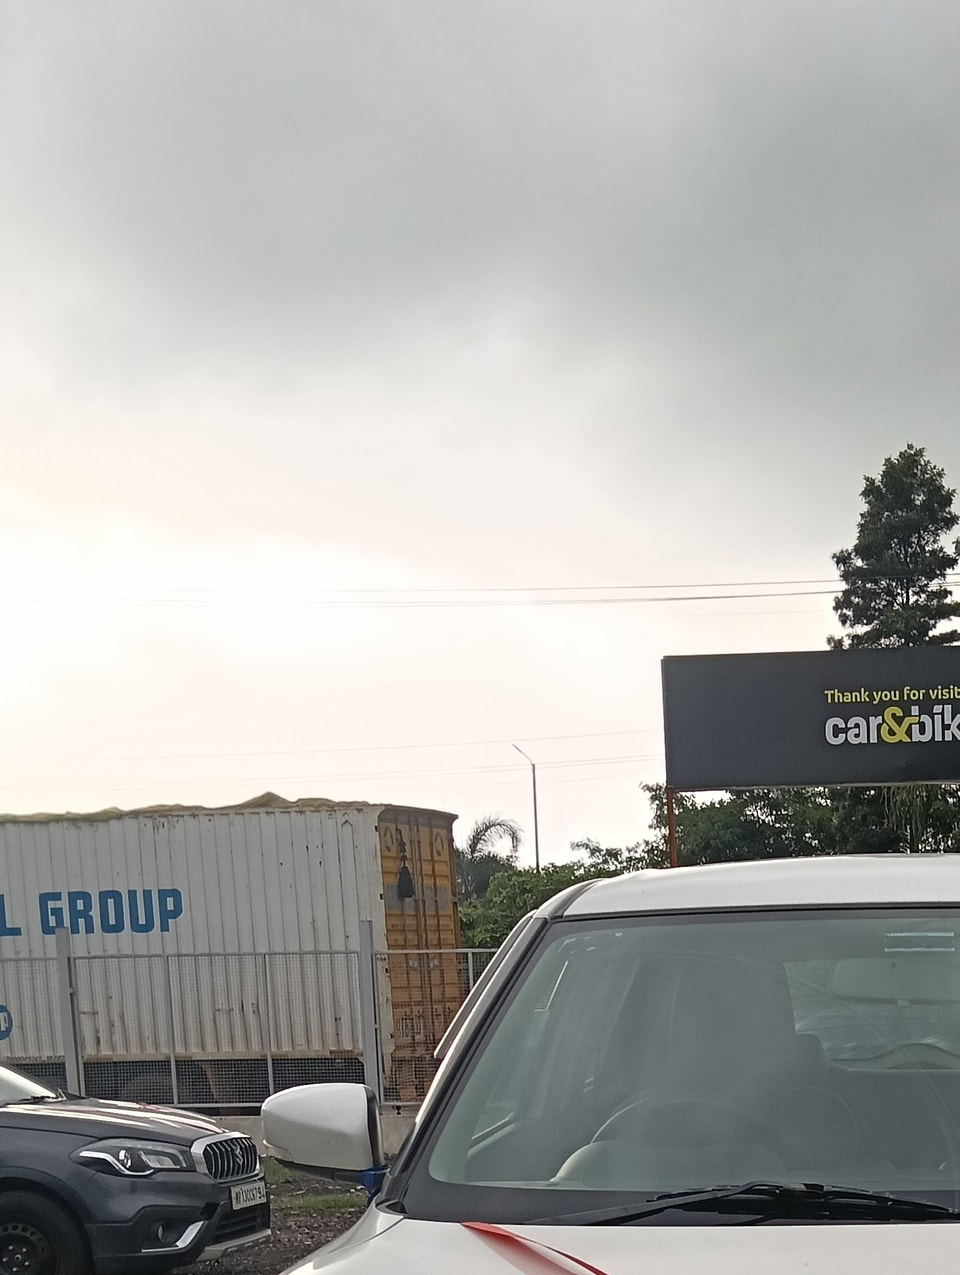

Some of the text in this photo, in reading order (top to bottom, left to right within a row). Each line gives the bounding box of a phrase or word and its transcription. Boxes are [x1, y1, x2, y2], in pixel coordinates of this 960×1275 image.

[824, 688, 870, 704] Thank
[872, 690, 900, 705] you
[903, 686, 926, 701] for
[38, 888, 183, 936] GROUP
